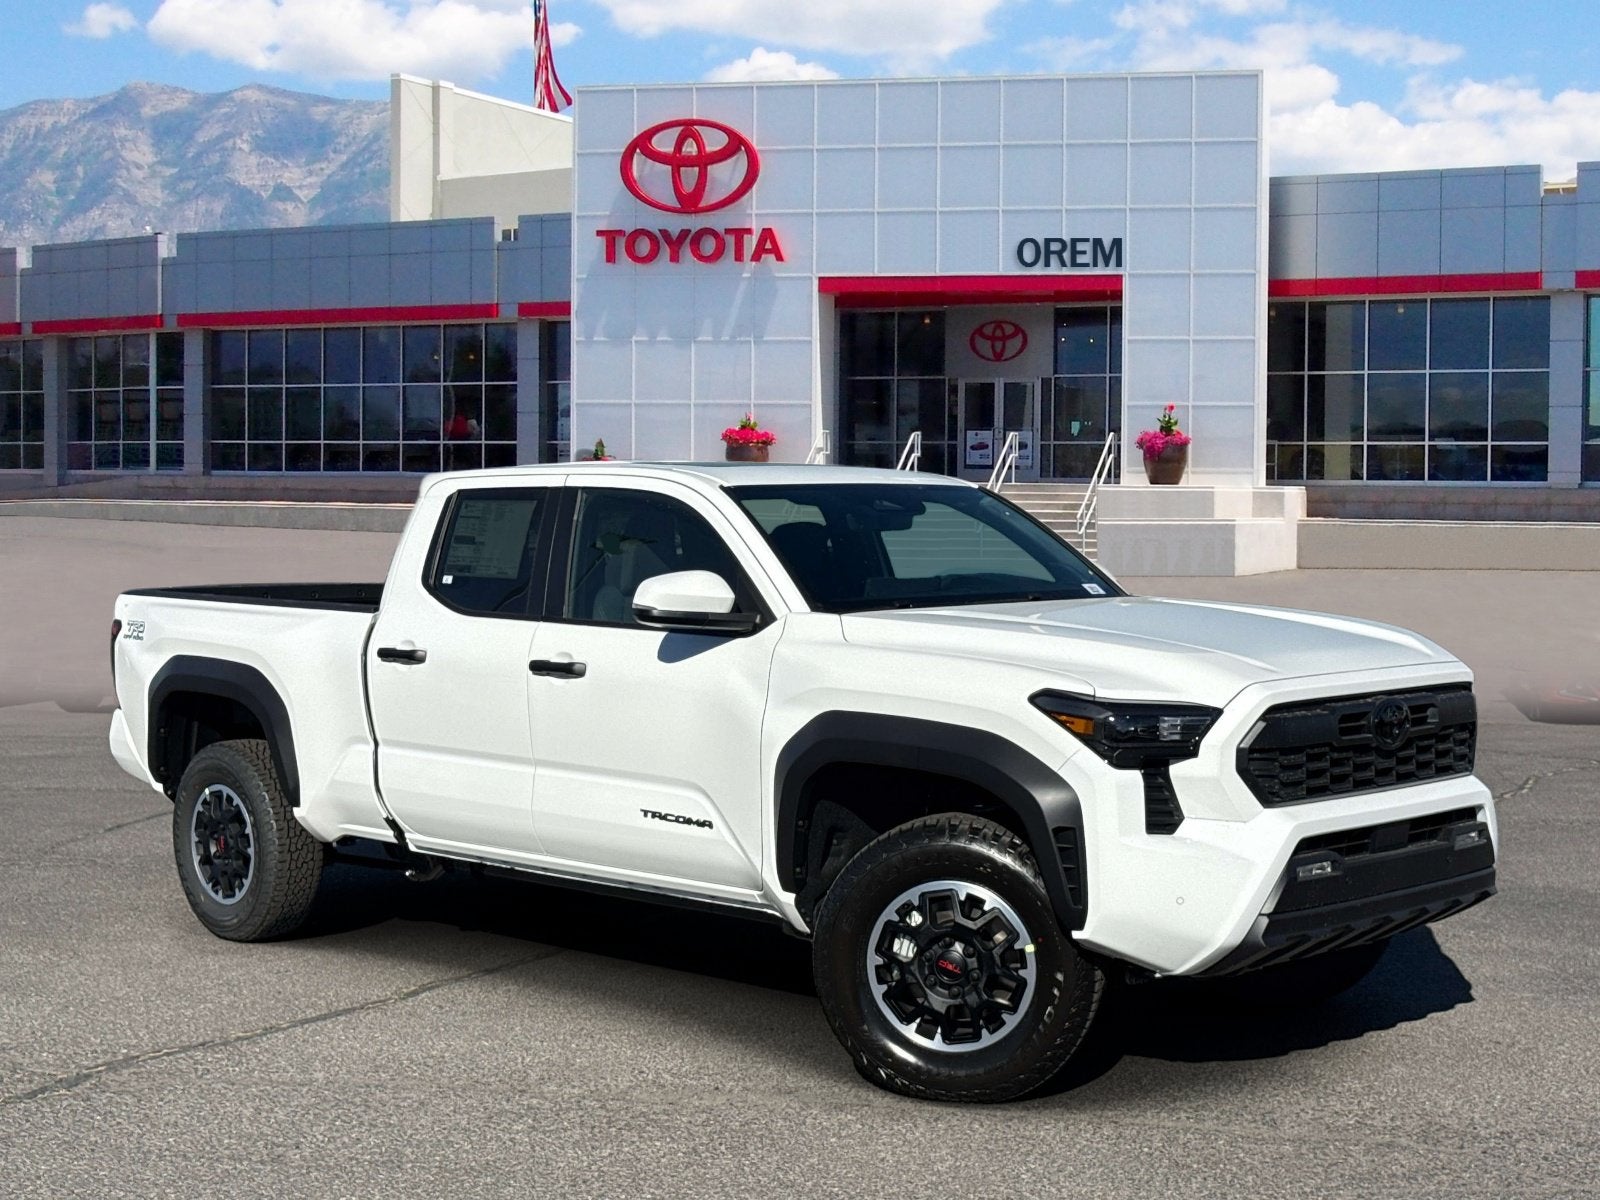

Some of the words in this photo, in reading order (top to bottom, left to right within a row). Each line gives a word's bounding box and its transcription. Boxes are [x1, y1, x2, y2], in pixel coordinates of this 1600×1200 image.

[596, 227, 785, 264] TOYOTA
[1016, 237, 1123, 268] OREM
[640, 808, 713, 829] TACOMA
